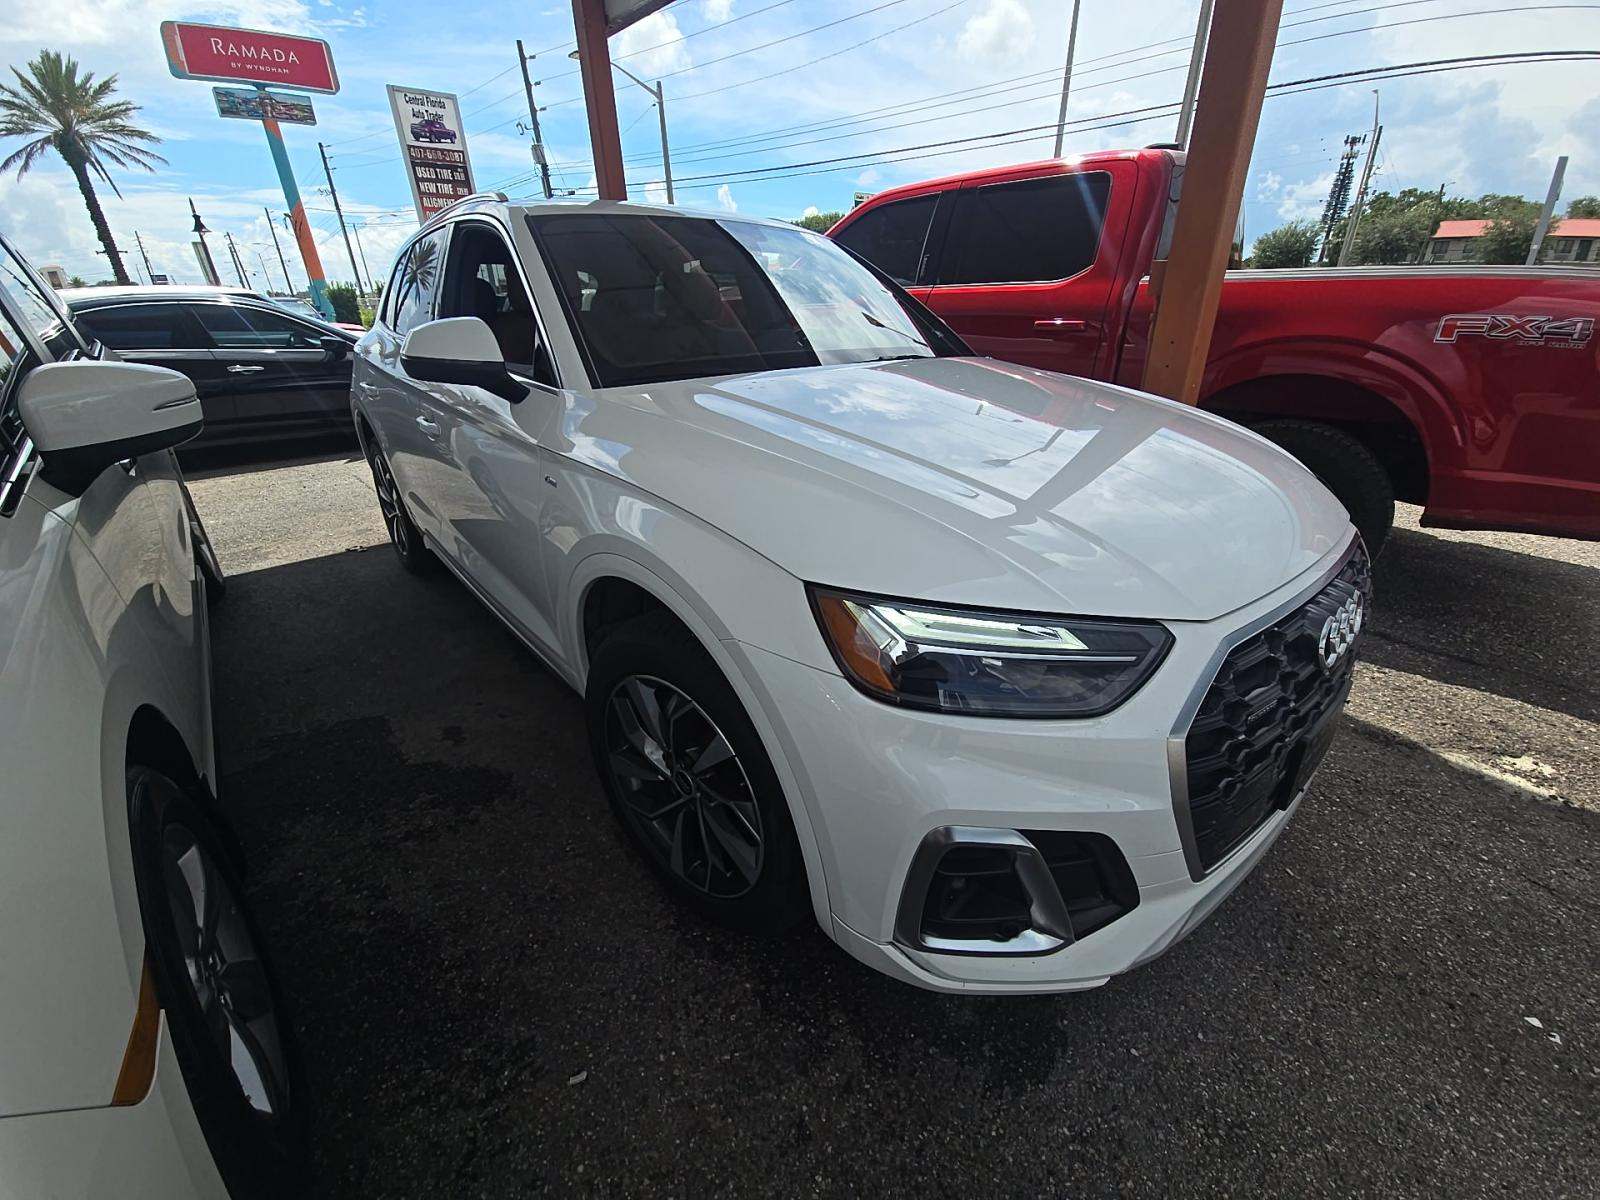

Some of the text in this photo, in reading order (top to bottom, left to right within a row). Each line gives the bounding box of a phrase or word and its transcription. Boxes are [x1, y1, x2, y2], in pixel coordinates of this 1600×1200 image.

[210, 38, 300, 64] RAMADA
[245, 64, 290, 74] WYNDHAM
[404, 93, 446, 109] Central Florida
[411, 107, 444, 121] Auto Trader
[415, 166, 436, 179] USED
[436, 168, 453, 180] TIRE
[419, 182, 436, 193] NEW
[436, 183, 454, 195] TIRE
[1433, 313, 1596, 344] FX4
